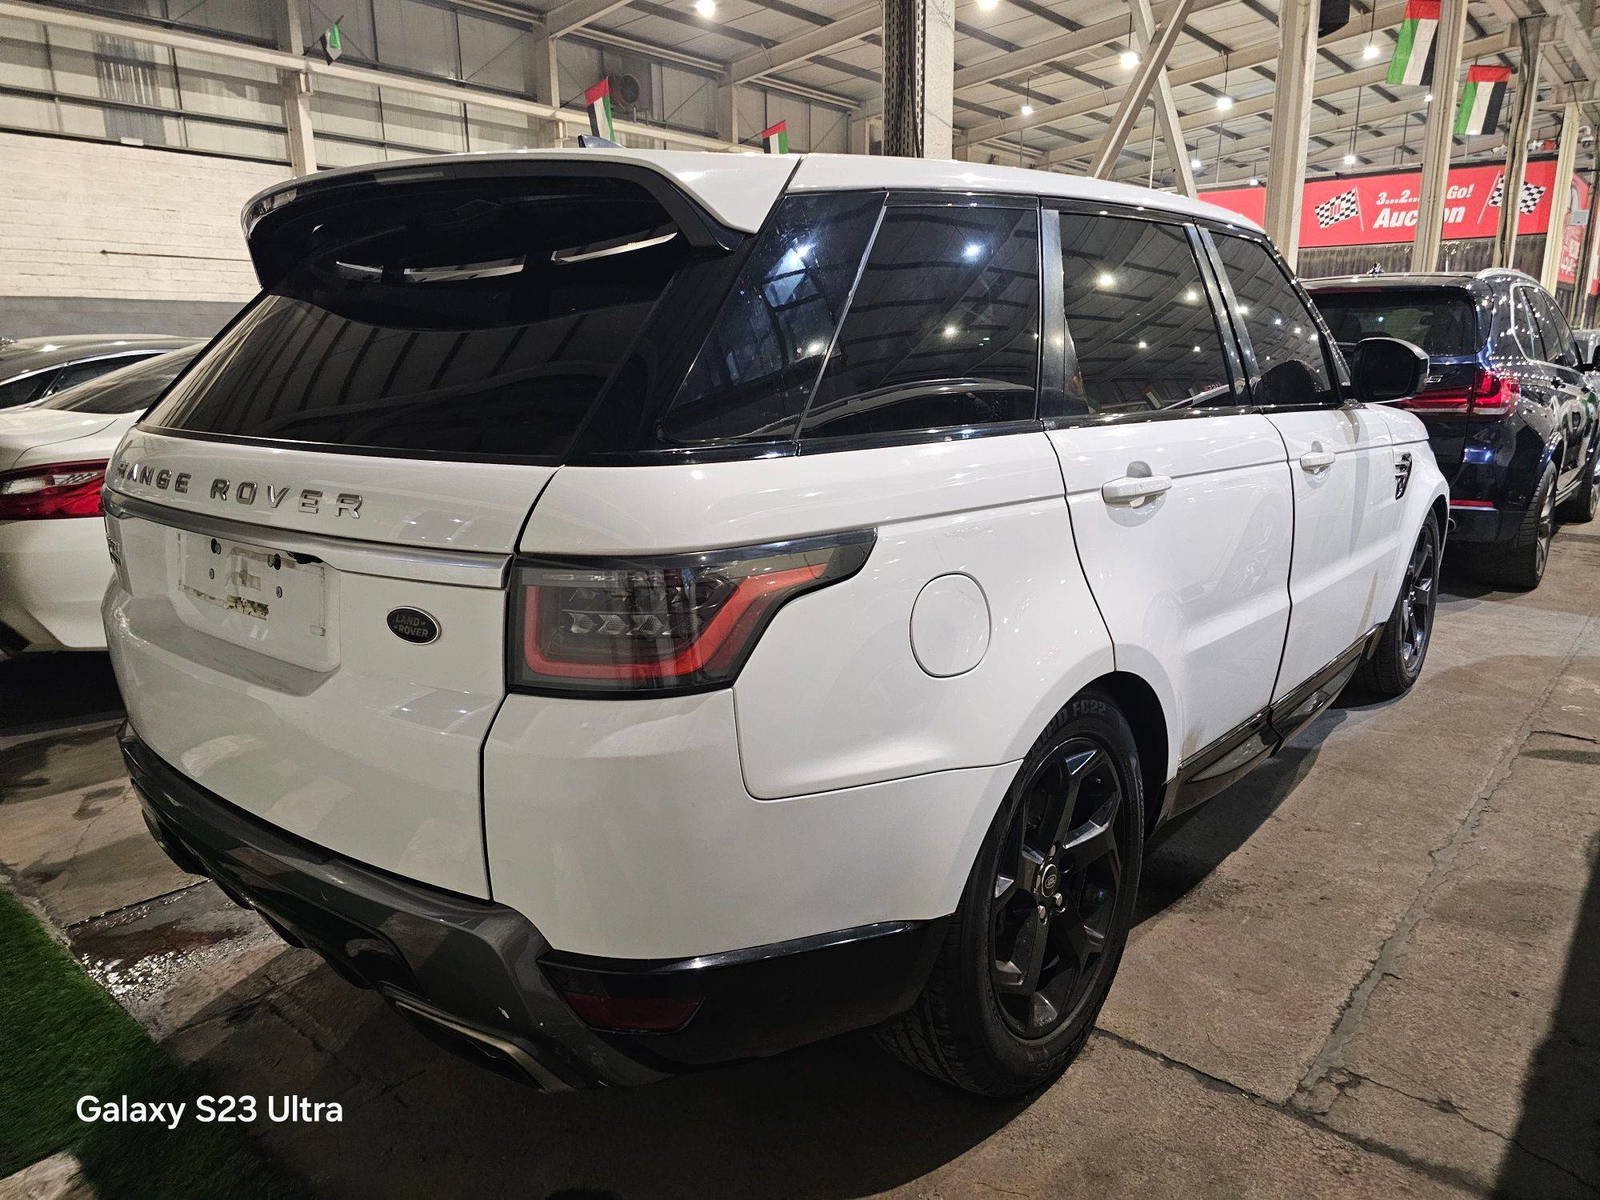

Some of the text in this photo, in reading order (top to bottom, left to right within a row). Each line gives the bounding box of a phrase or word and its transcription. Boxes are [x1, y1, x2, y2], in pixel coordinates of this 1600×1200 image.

[1446, 183, 1475, 199] Go!
[1372, 206, 1466, 229] Aucn
[117, 461, 363, 519] RANGE ROVER
[396, 614, 420, 627] LAND
[398, 624, 429, 638] ROVER
